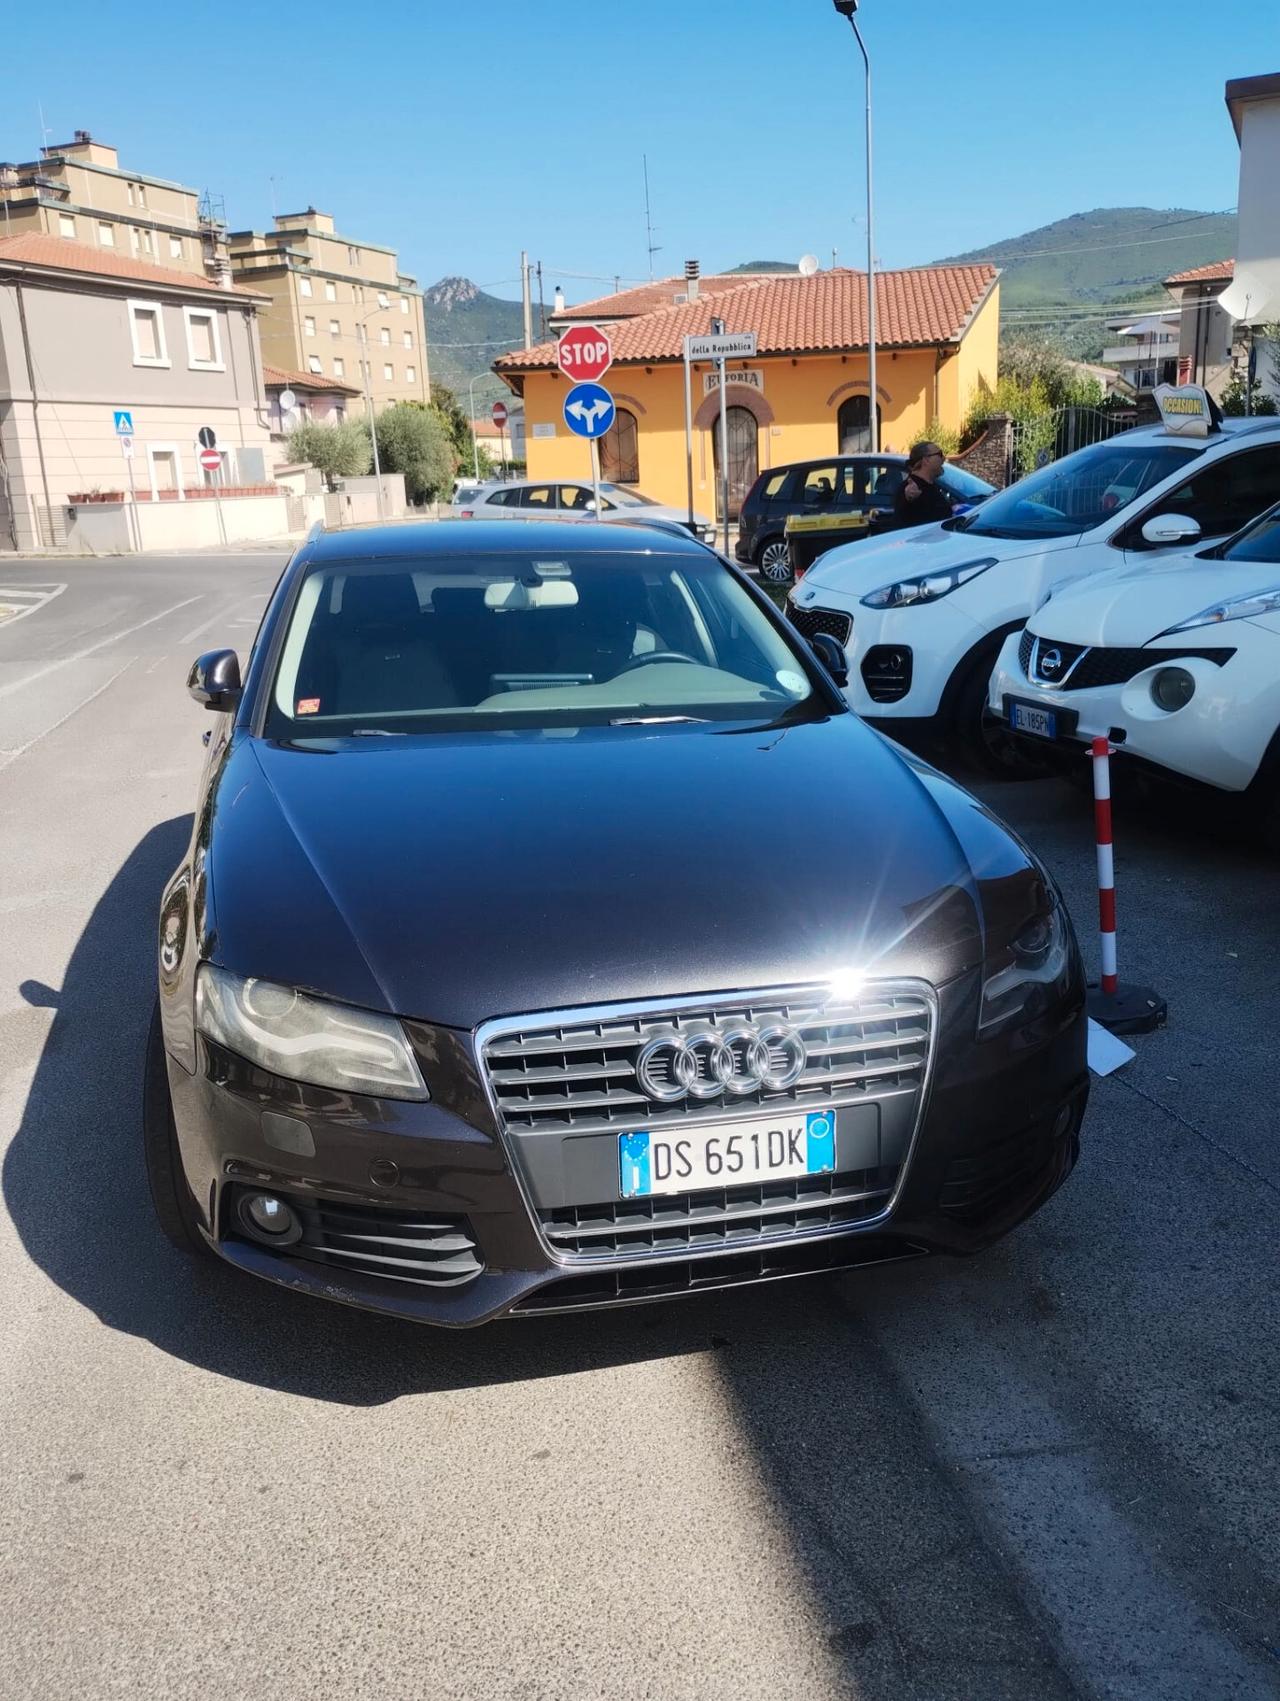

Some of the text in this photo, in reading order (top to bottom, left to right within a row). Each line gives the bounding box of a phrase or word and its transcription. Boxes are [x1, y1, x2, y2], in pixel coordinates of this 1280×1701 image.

[560, 342, 608, 366] STOP
[691, 342, 752, 354] della Repubblica
[654, 1140, 693, 1181] DS
[705, 1128, 804, 1176] 651DK
